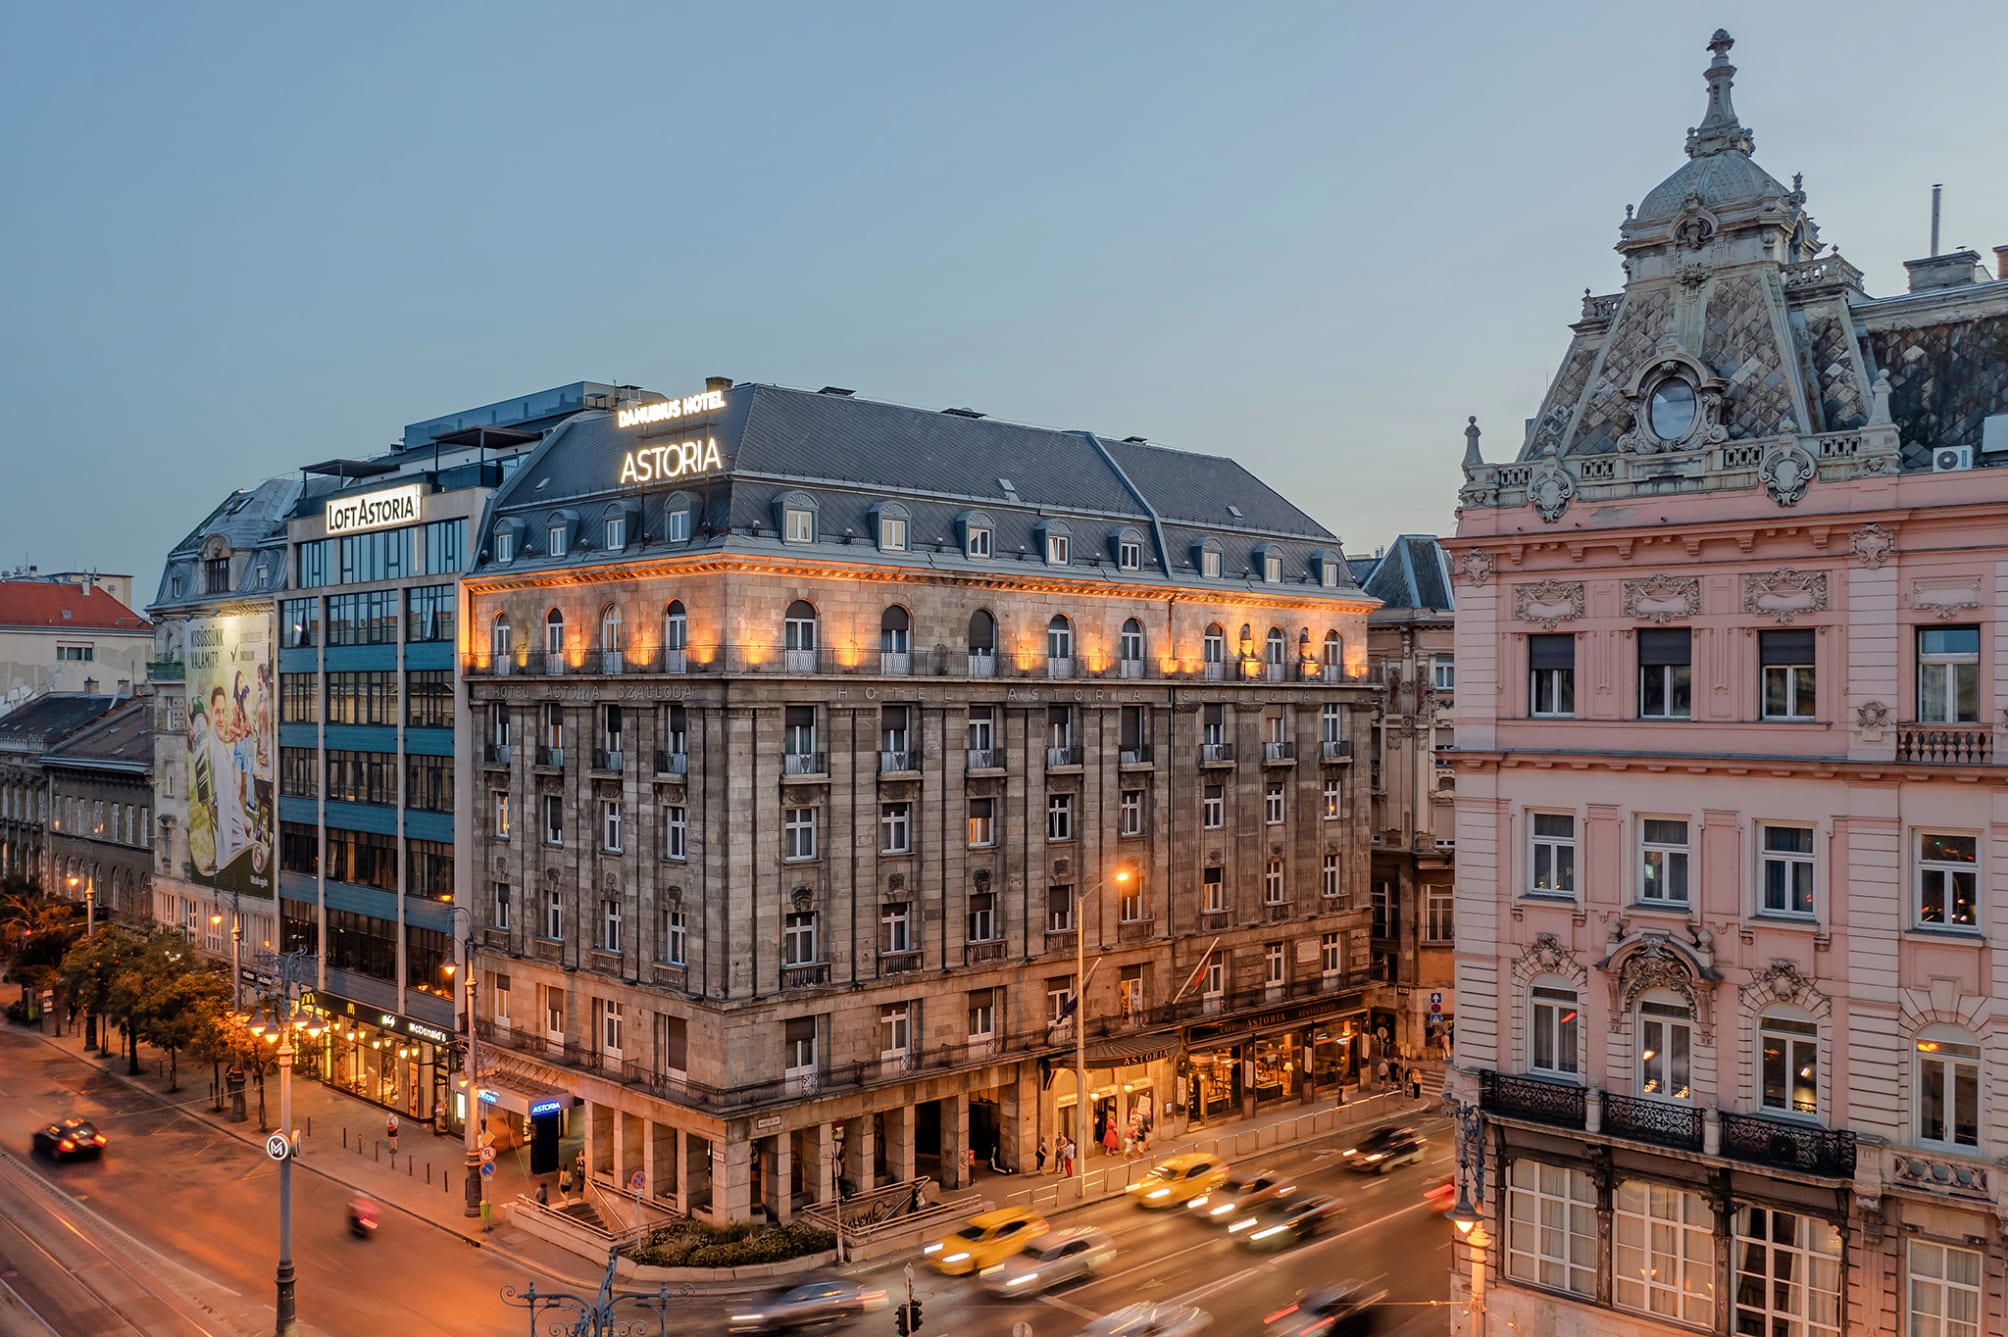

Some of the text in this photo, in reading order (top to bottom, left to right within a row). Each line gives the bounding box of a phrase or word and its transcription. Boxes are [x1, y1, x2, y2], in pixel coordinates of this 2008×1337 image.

[618, 390, 726, 428] DANUBIUS HOTEL
[620, 437, 723, 484] ASTORIA
[493, 685, 529, 699] HOTEL
[546, 685, 600, 699] ASTORIA
[837, 686, 954, 701] HOTEL
[1006, 687, 1142, 701] ASTORIA
[1246, 1012, 1286, 1030] ASTORIA
[408, 1022, 447, 1042] McDonald's
[1123, 1049, 1169, 1066] ASTORIA
[532, 1101, 560, 1114] ASTORIA
